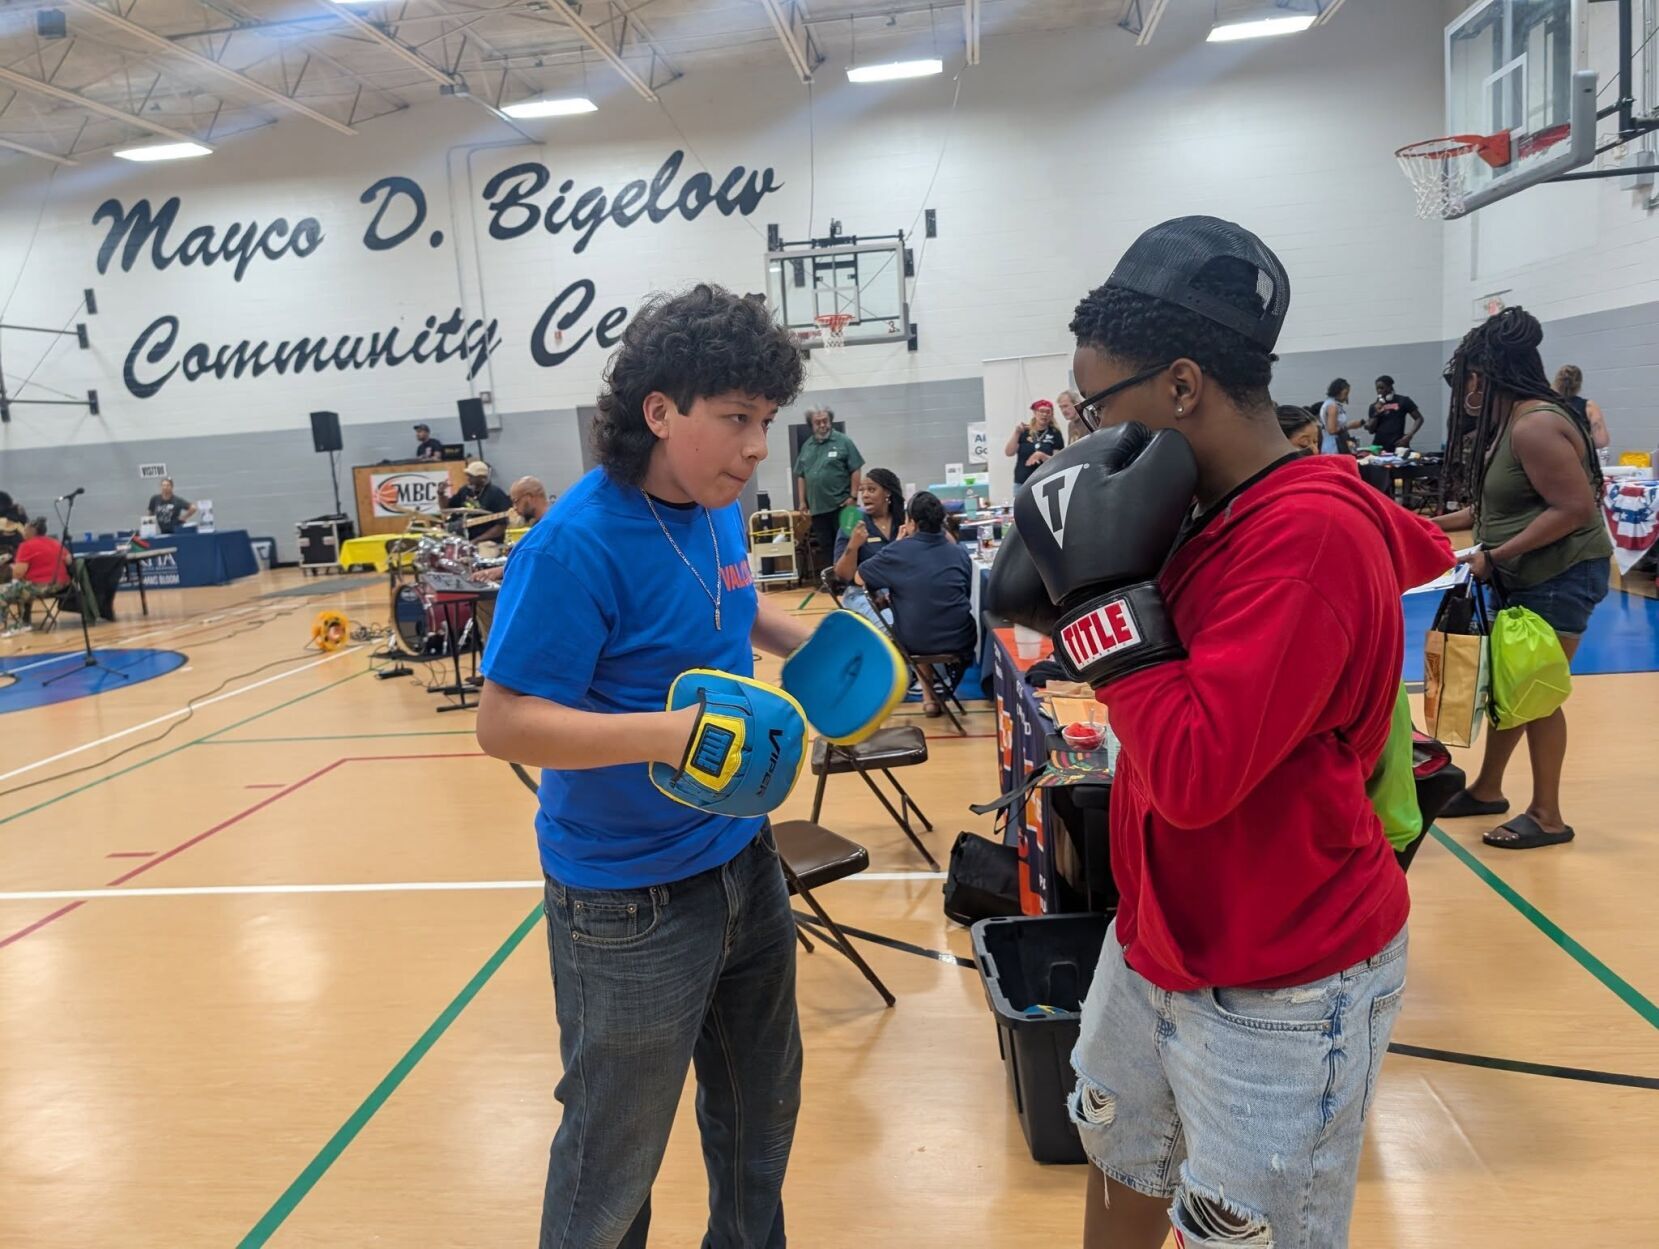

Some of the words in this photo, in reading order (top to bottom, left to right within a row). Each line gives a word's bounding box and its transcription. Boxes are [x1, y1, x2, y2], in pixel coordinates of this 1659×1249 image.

[92, 196, 326, 282] Mayco
[359, 176, 444, 250] D.
[483, 150, 785, 254] Bigelow
[124, 307, 502, 399] Community
[1042, 475, 1066, 533] T
[1062, 603, 1133, 665] TITLE
[756, 728, 784, 798] VIPER
